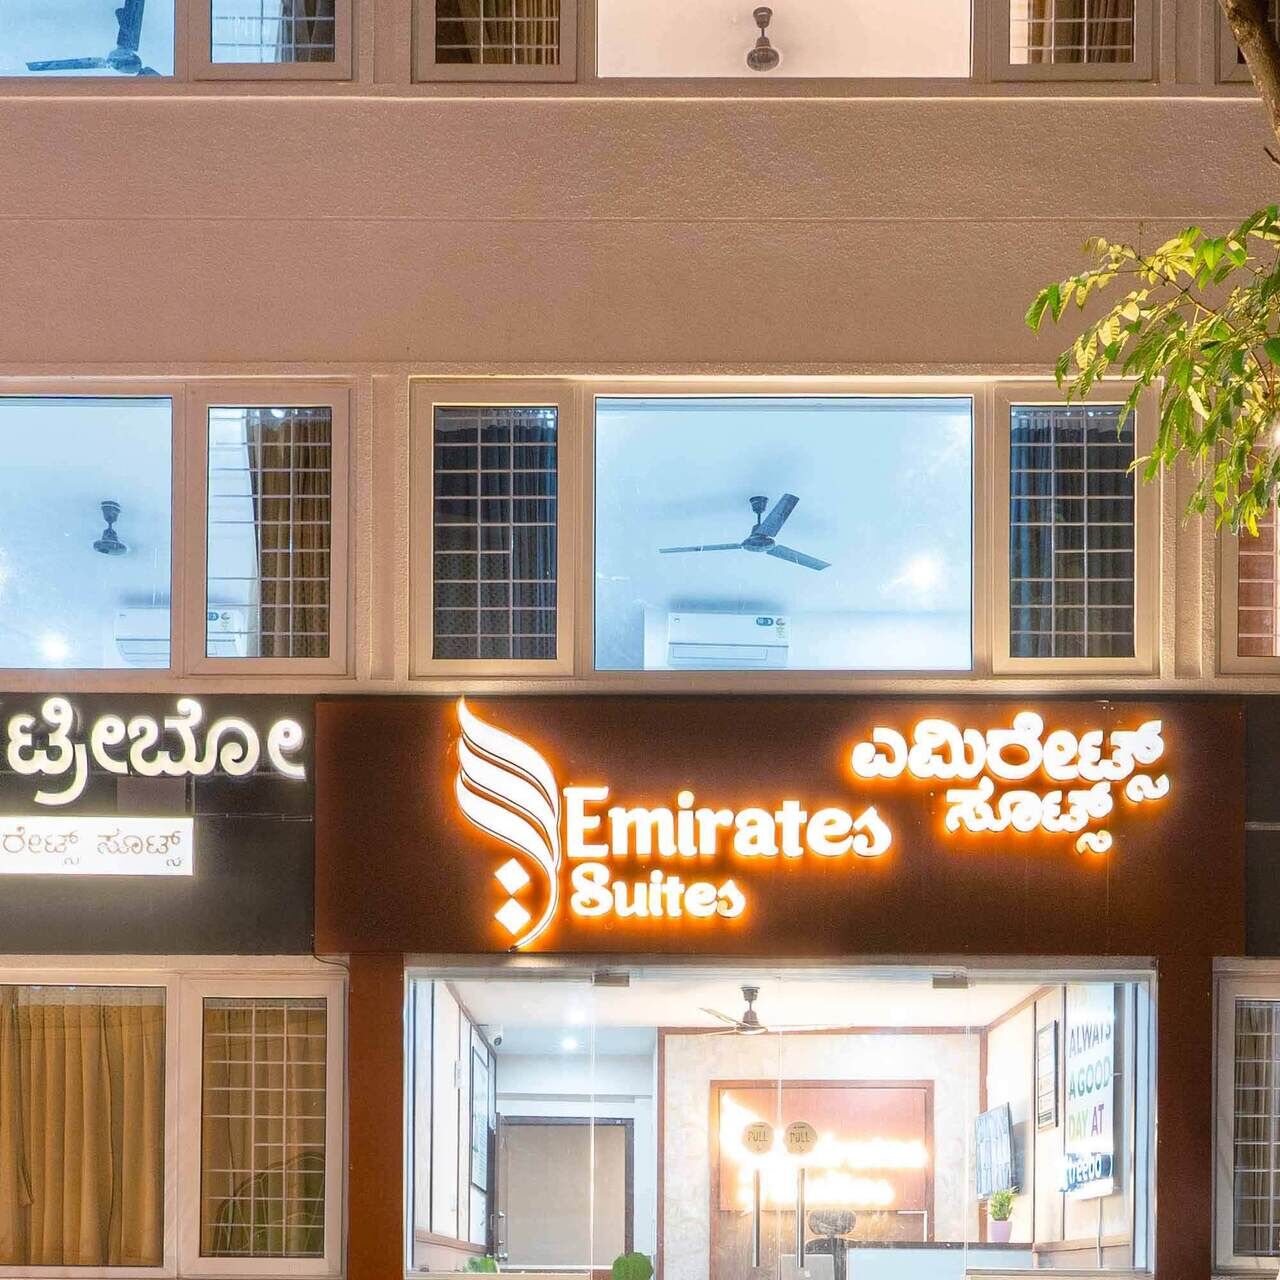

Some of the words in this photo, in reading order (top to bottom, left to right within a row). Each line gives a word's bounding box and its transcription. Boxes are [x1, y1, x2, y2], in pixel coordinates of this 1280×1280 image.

[563, 786, 893, 858] Emirates
[570, 863, 747, 918] Suites
[1077, 1057, 1111, 1097] GOOD
[1090, 1103, 1105, 1137] AT
